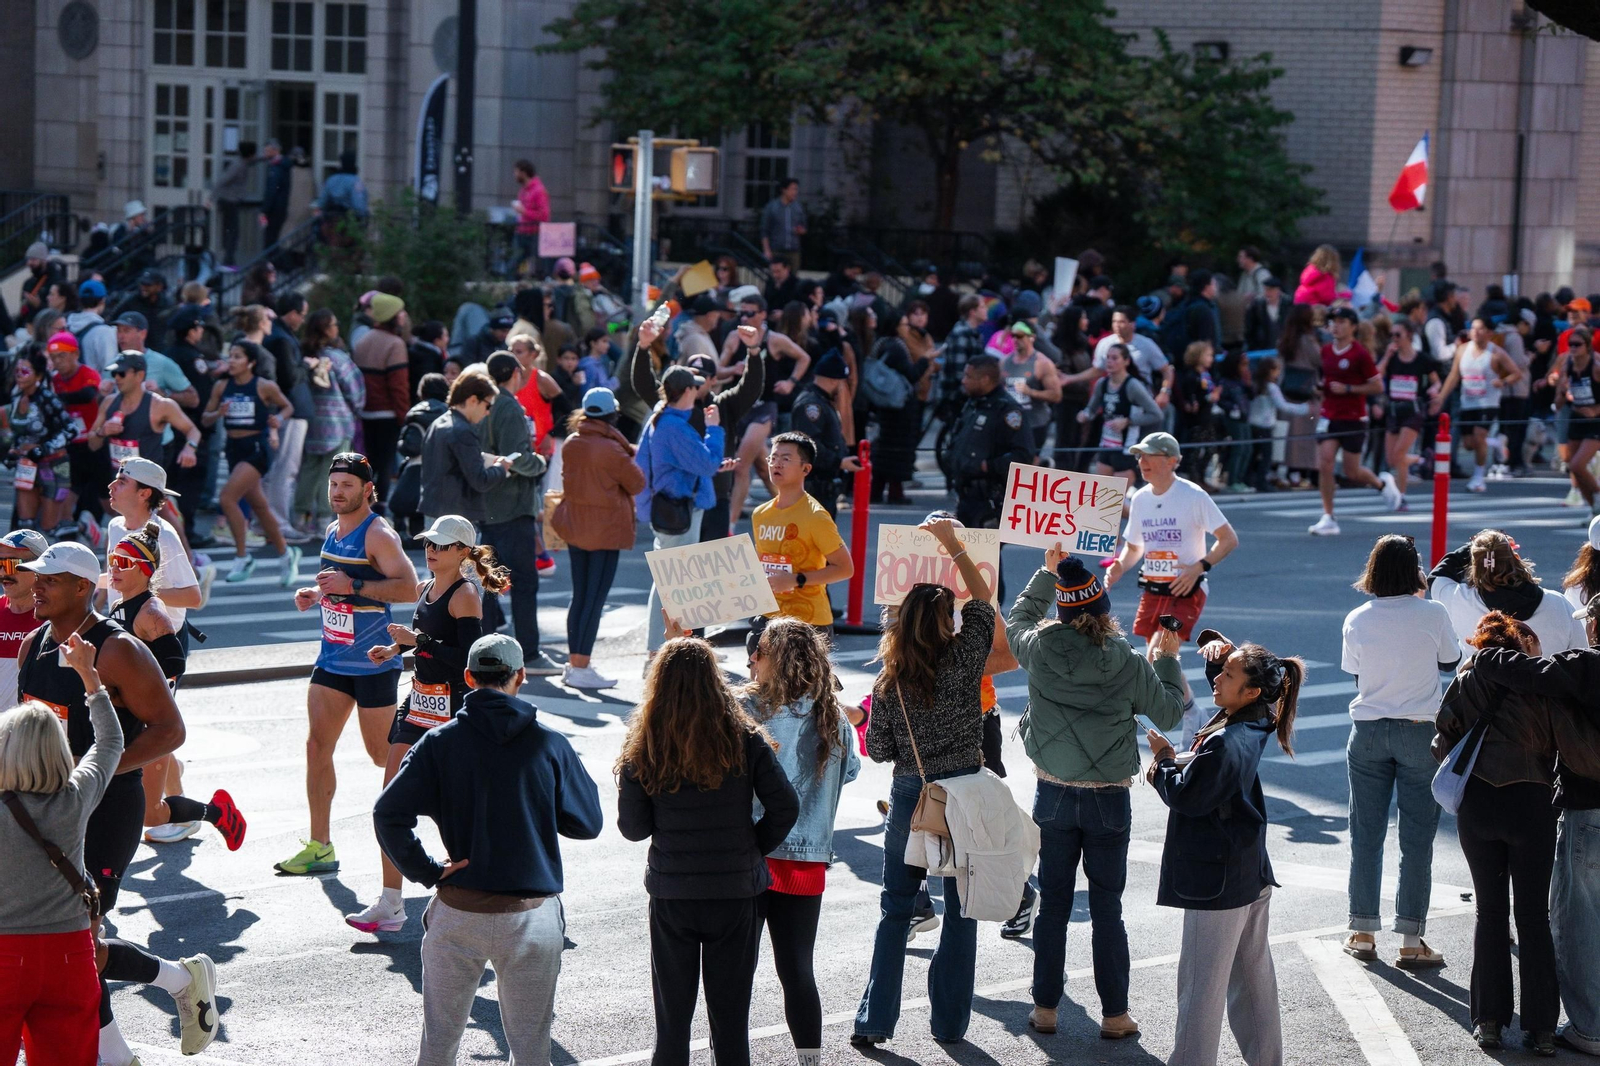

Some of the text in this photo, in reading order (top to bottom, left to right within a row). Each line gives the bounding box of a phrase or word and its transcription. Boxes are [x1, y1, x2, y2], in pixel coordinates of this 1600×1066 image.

[1011, 468, 1098, 513] HIGH
[1008, 504, 1076, 535] FIVES
[1141, 518, 1176, 527] WILLIAM
[759, 525, 786, 541] DAYU
[1076, 530, 1117, 553] HERE
[1145, 560, 1173, 572] 14921
[1055, 581, 1100, 602] RUN NYC
[323, 608, 348, 628] 12817
[412, 691, 446, 711] 14898
